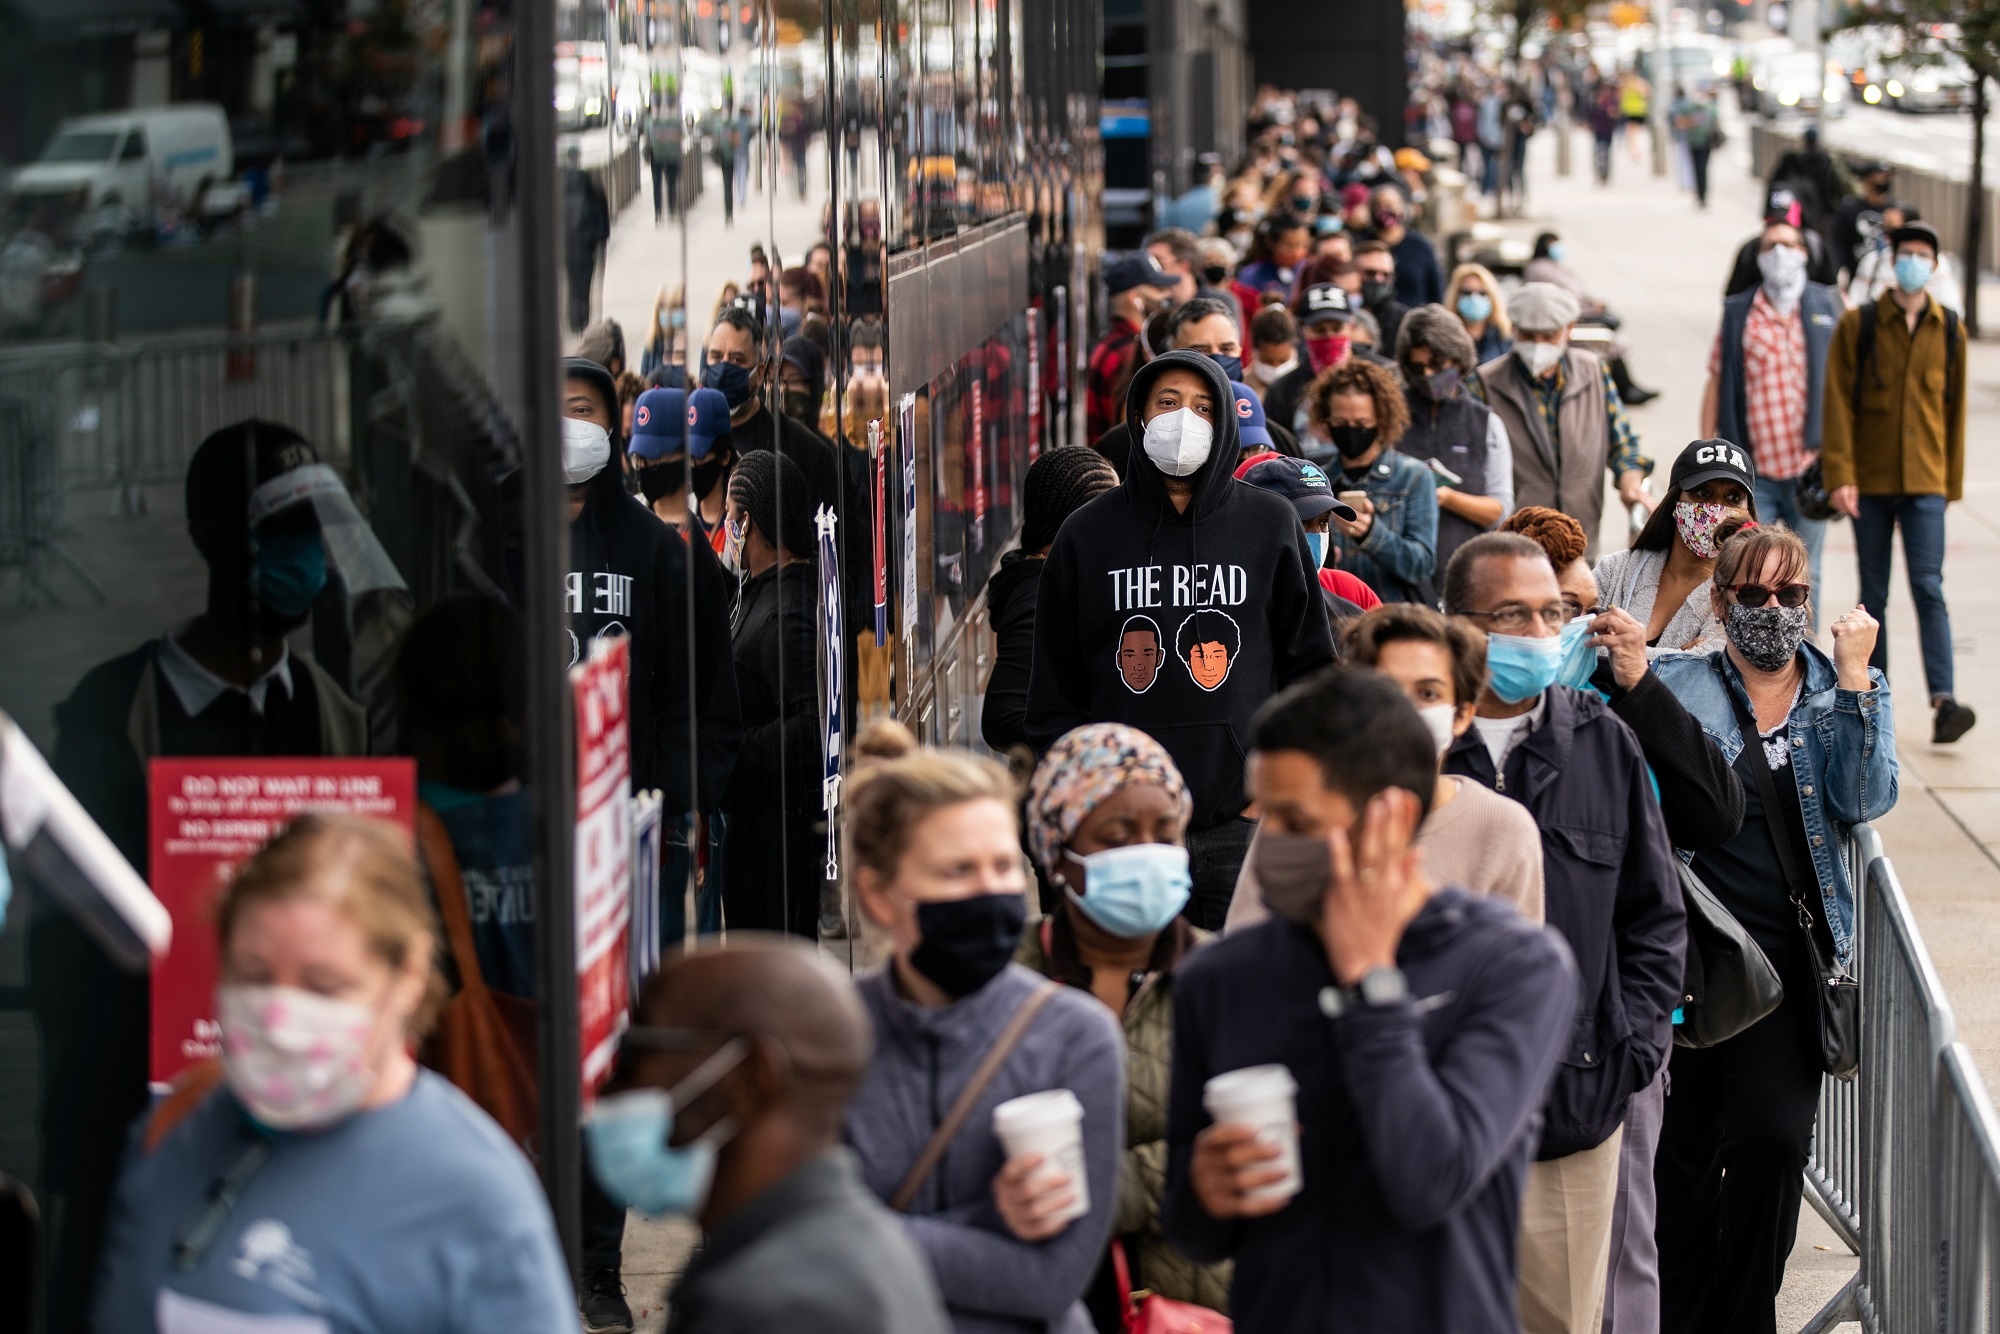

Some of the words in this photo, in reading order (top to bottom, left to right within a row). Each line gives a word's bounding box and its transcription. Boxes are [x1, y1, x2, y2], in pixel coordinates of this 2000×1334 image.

[1236, 398, 1253, 418] C
[1696, 445, 1747, 472] CIA
[1107, 566, 1162, 611] THE
[1173, 564, 1247, 606] READ
[182, 776, 216, 796] DO
[219, 776, 259, 796] NOT
[263, 776, 310, 796] WAIT
[314, 776, 336, 796] IN
[340, 776, 381, 796] LINE
[181, 820, 209, 837] NO
